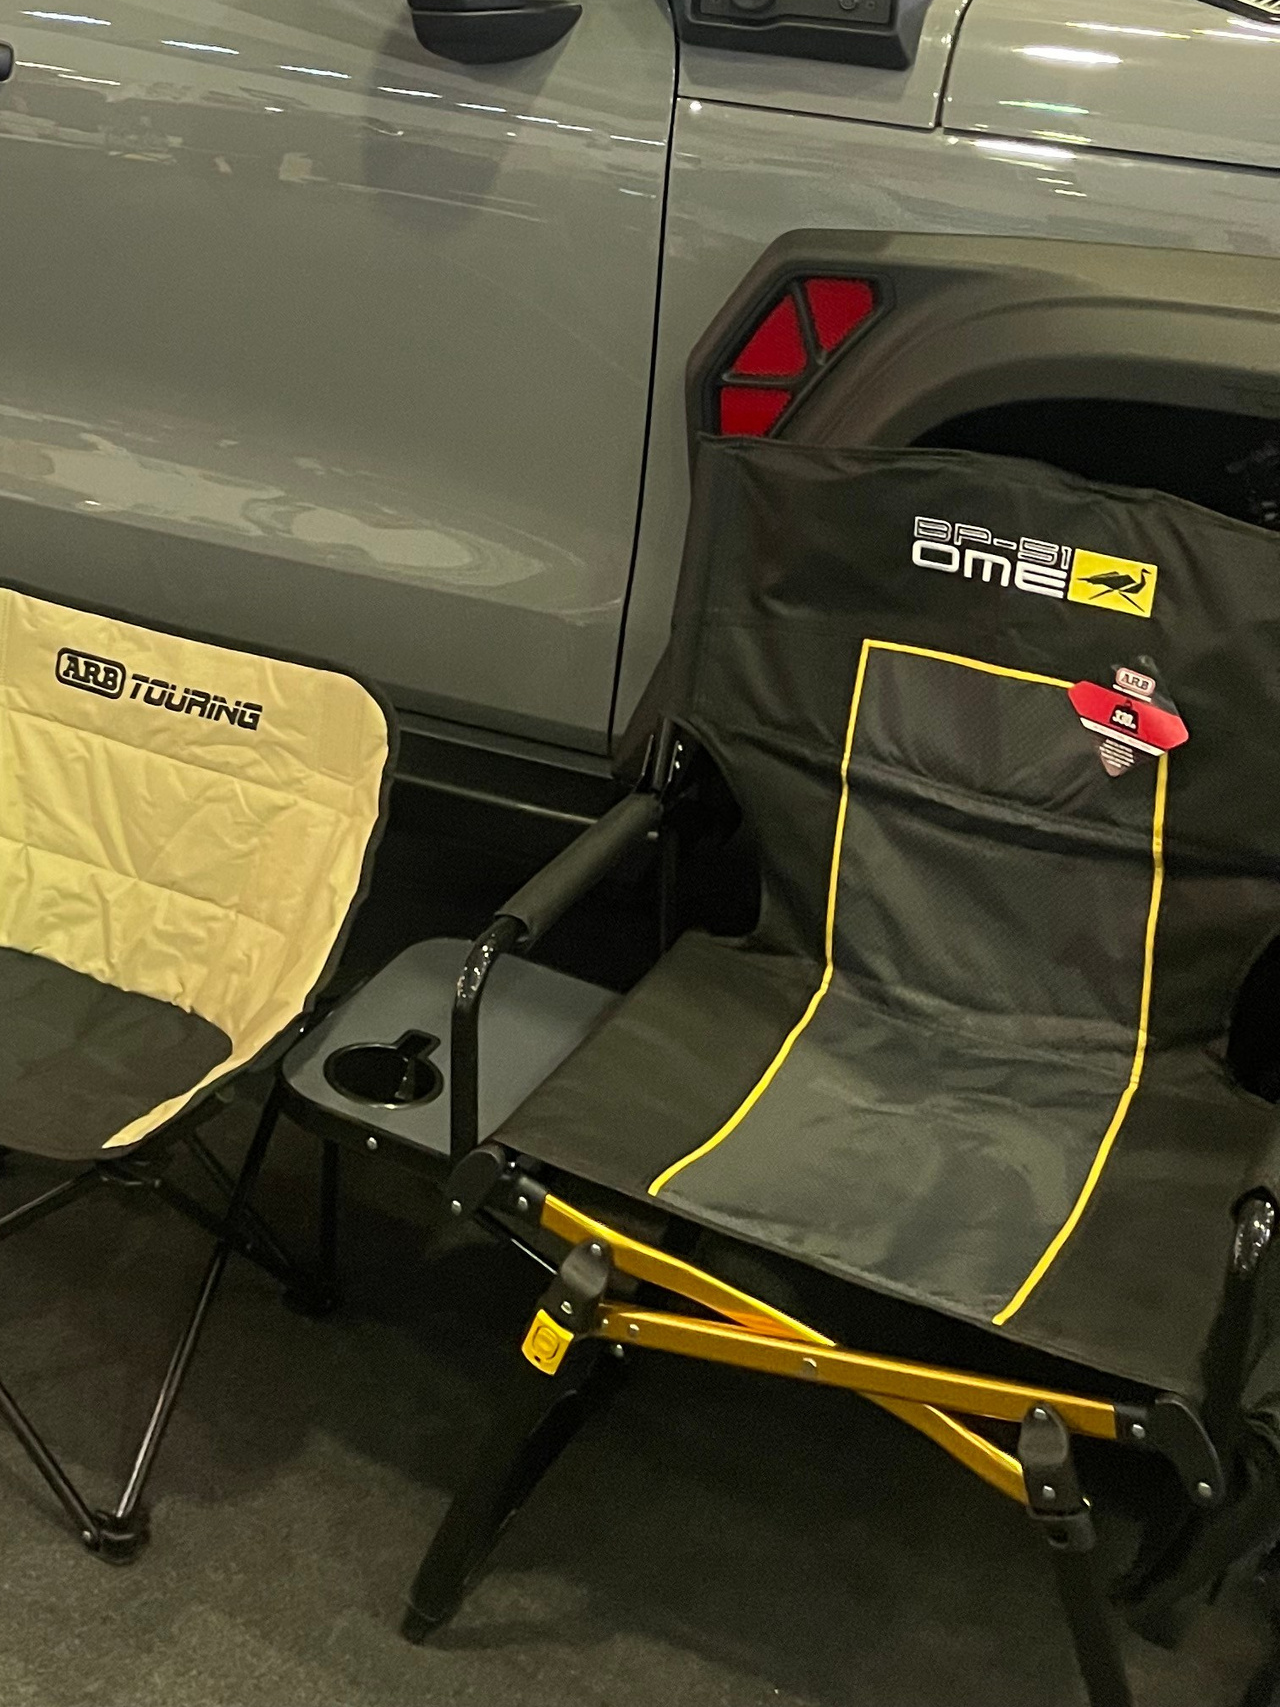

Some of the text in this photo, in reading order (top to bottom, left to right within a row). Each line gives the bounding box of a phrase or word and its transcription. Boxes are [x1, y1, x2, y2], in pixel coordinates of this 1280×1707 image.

[911, 539, 1069, 599] OME
[913, 516, 1072, 570] BP-51
[62, 655, 263, 731] ARB TOURING
[1121, 673, 1149, 691] ARB
